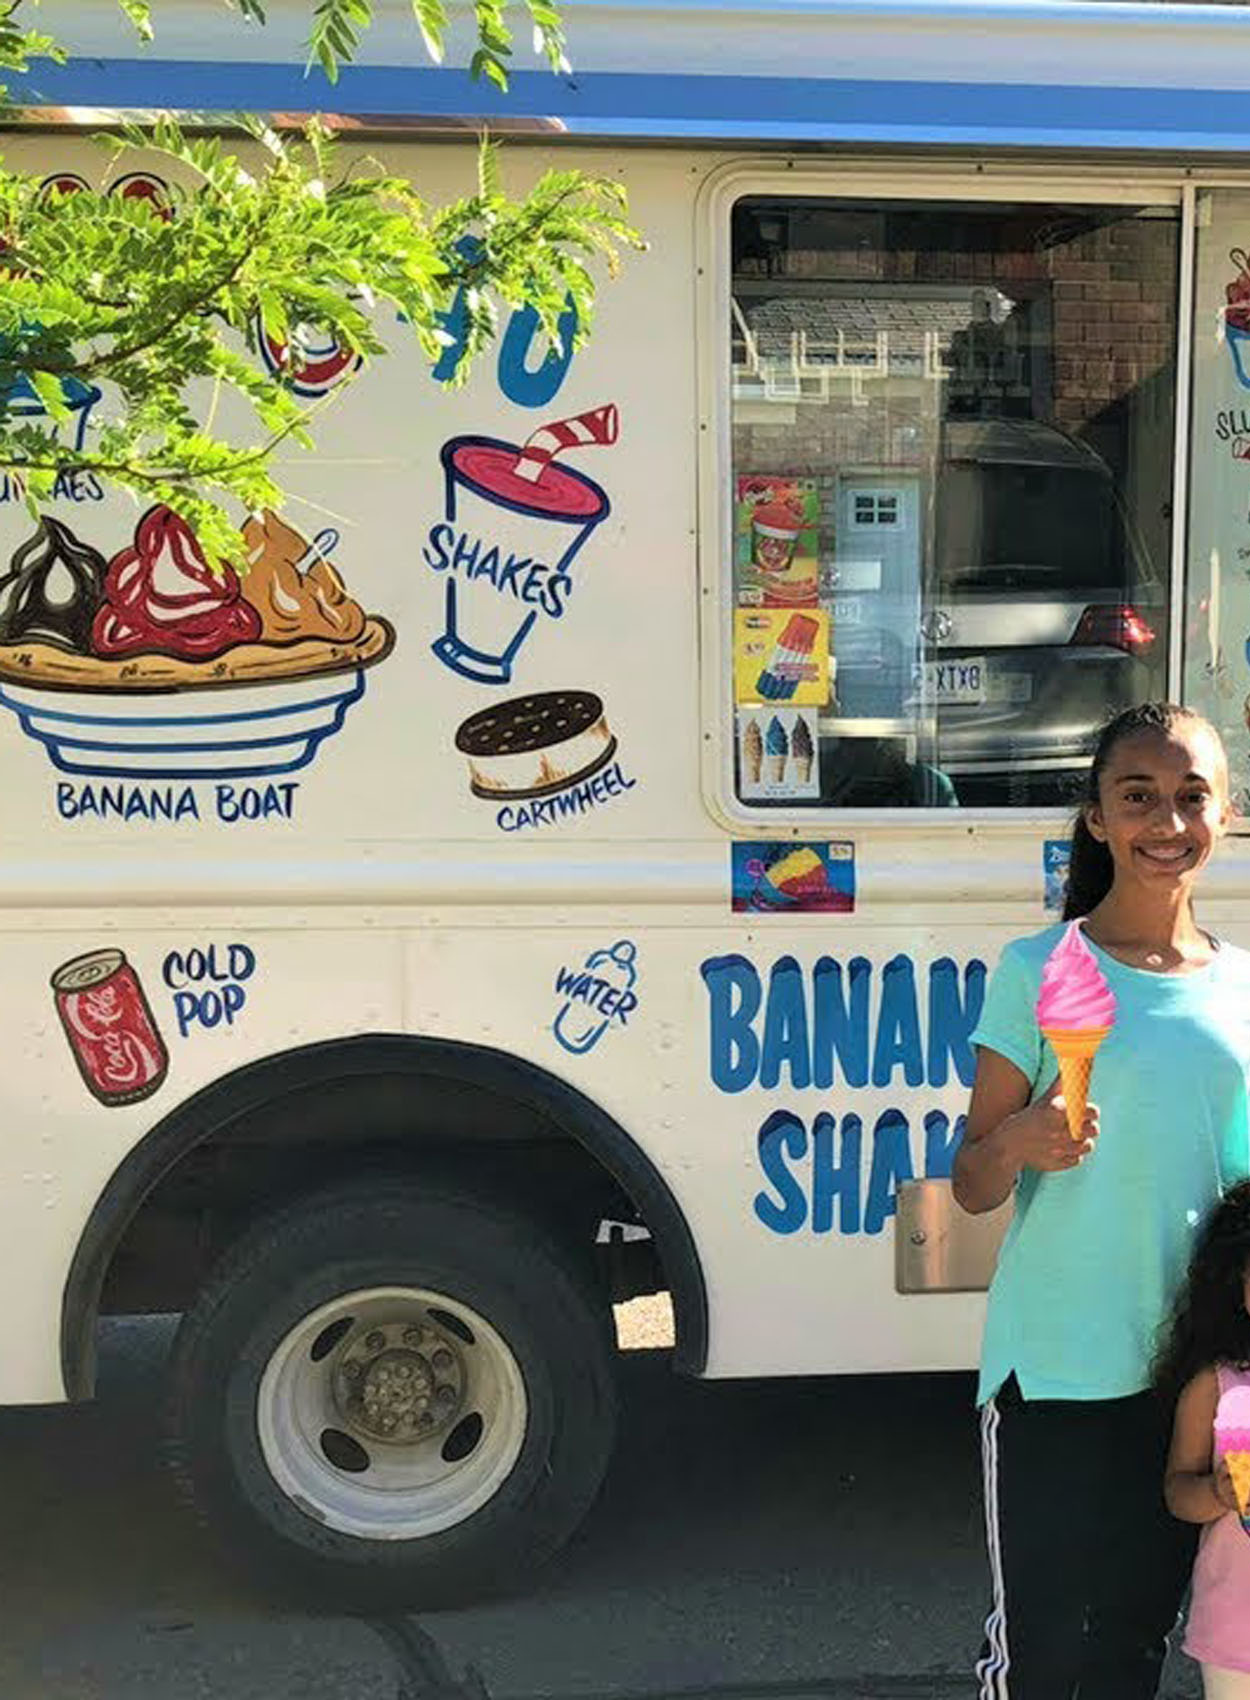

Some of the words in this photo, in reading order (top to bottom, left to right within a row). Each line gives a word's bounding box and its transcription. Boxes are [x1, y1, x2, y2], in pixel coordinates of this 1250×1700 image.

[422, 524, 572, 618] SHAKES
[57, 783, 200, 821] BANANA
[215, 783, 300, 822] BOAT
[497, 763, 636, 832] CARTWHEEL
[163, 943, 255, 989] COLD
[556, 966, 638, 1025] WATER
[172, 984, 246, 1037] POP
[700, 953, 988, 1093] BANAN
